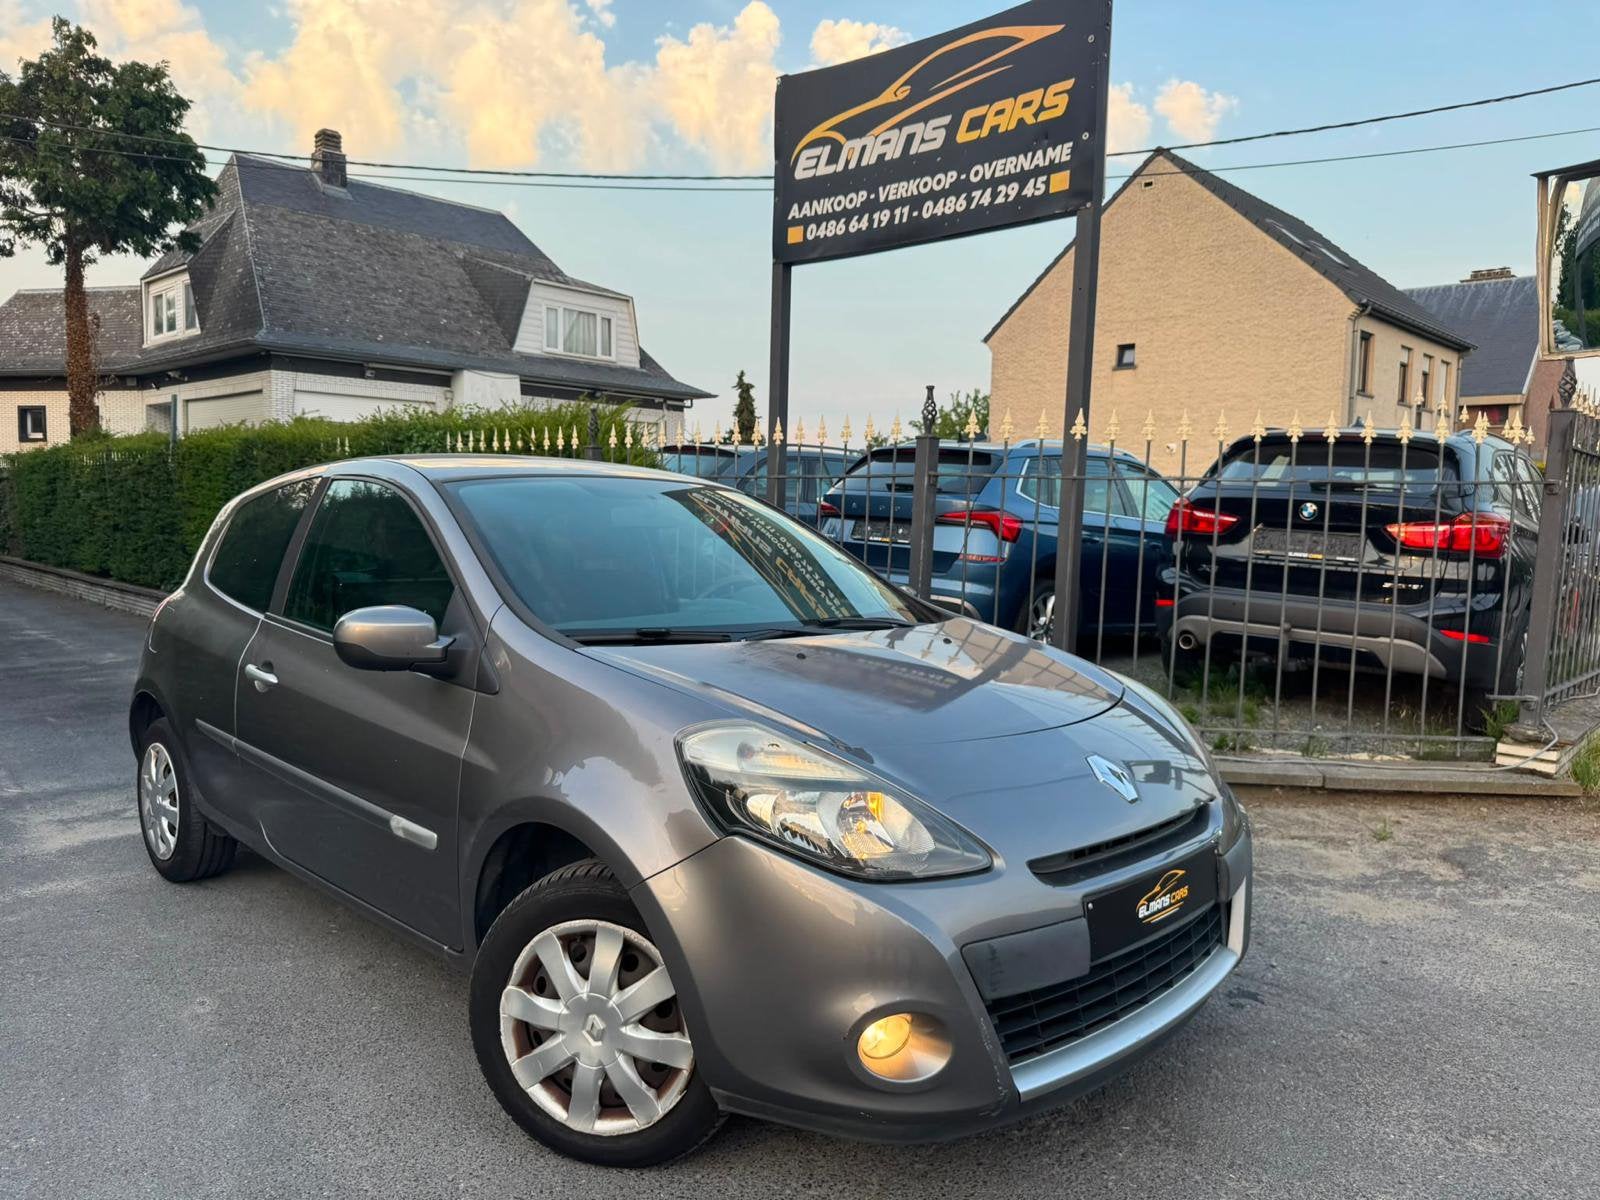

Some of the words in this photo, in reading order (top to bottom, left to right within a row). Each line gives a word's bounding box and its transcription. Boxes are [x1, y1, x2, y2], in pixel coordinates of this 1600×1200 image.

[794, 114, 952, 180] ELMANS
[956, 77, 1075, 144] CARS
[788, 190, 867, 220] AANKOOP
[878, 170, 958, 203] VERKOOP
[969, 141, 1073, 183] OVERNAME
[806, 217, 846, 241] 0486
[848, 212, 869, 233] 64
[872, 208, 891, 229] 19
[894, 205, 910, 225] 11
[922, 193, 967, 219] 0486
[970, 187, 992, 210] 74
[994, 182, 1020, 205] 29
[1021, 175, 1048, 198] 45
